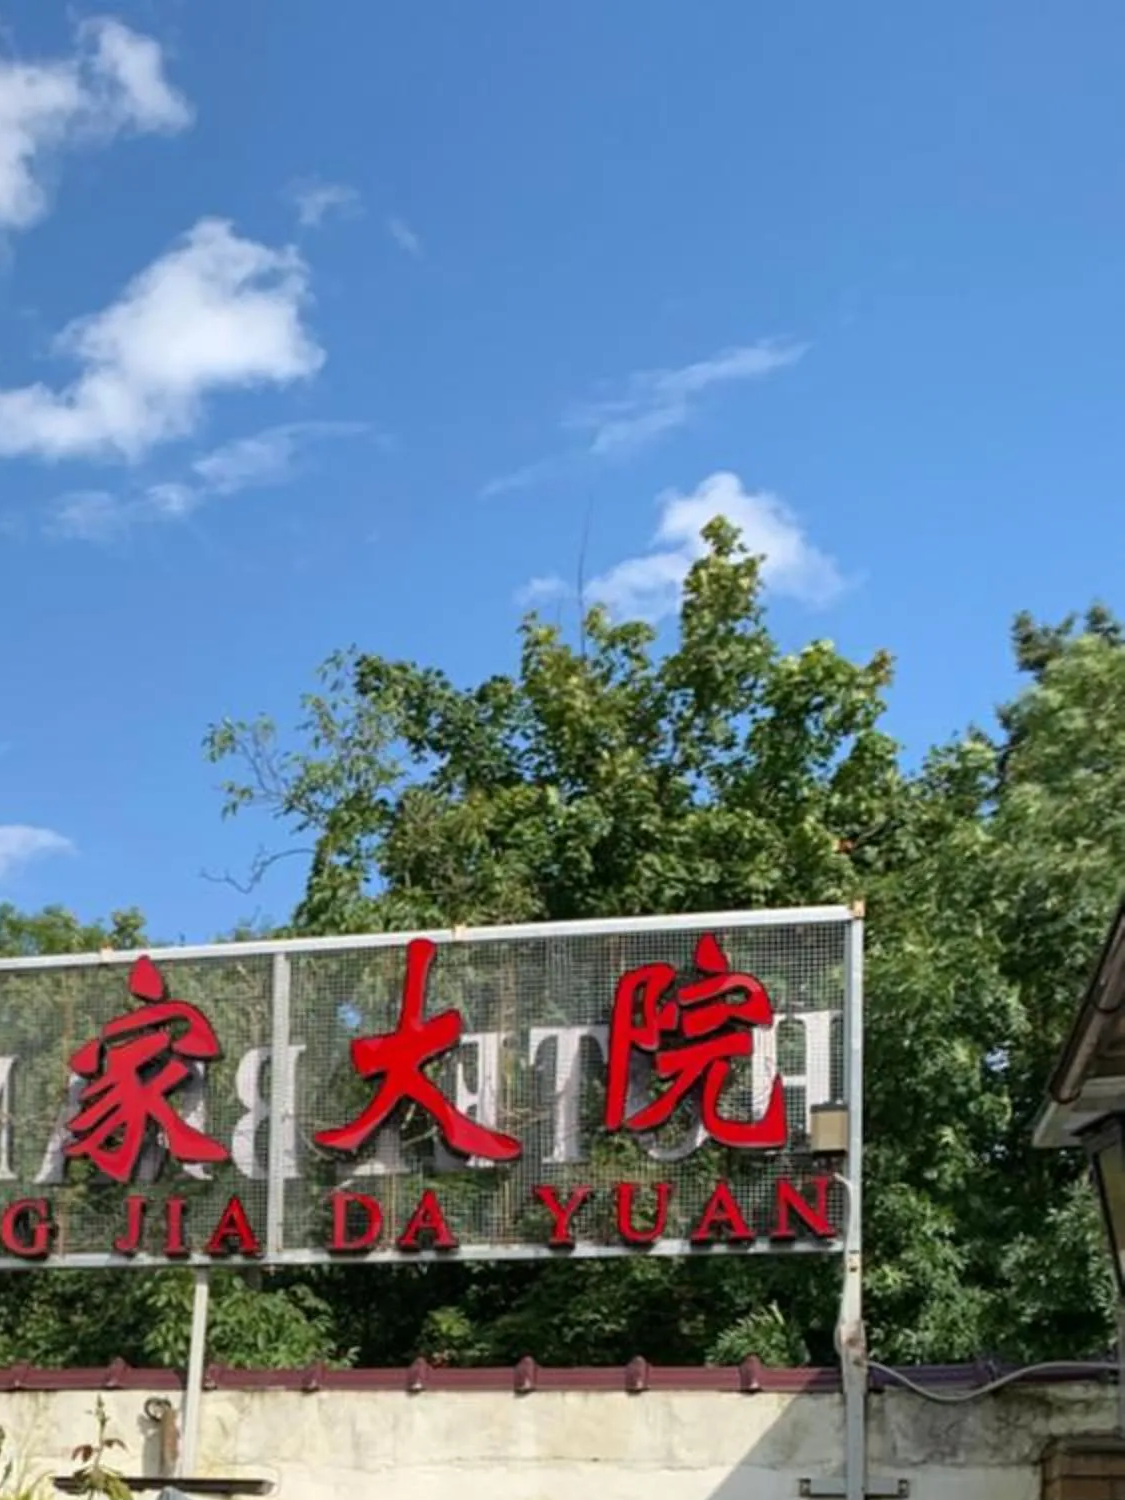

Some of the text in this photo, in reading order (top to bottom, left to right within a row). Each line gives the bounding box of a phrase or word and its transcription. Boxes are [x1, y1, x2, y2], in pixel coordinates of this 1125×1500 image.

[114, 1194, 261, 1258] JIA
[327, 1188, 459, 1254] DA
[532, 1173, 838, 1248] YUAN
